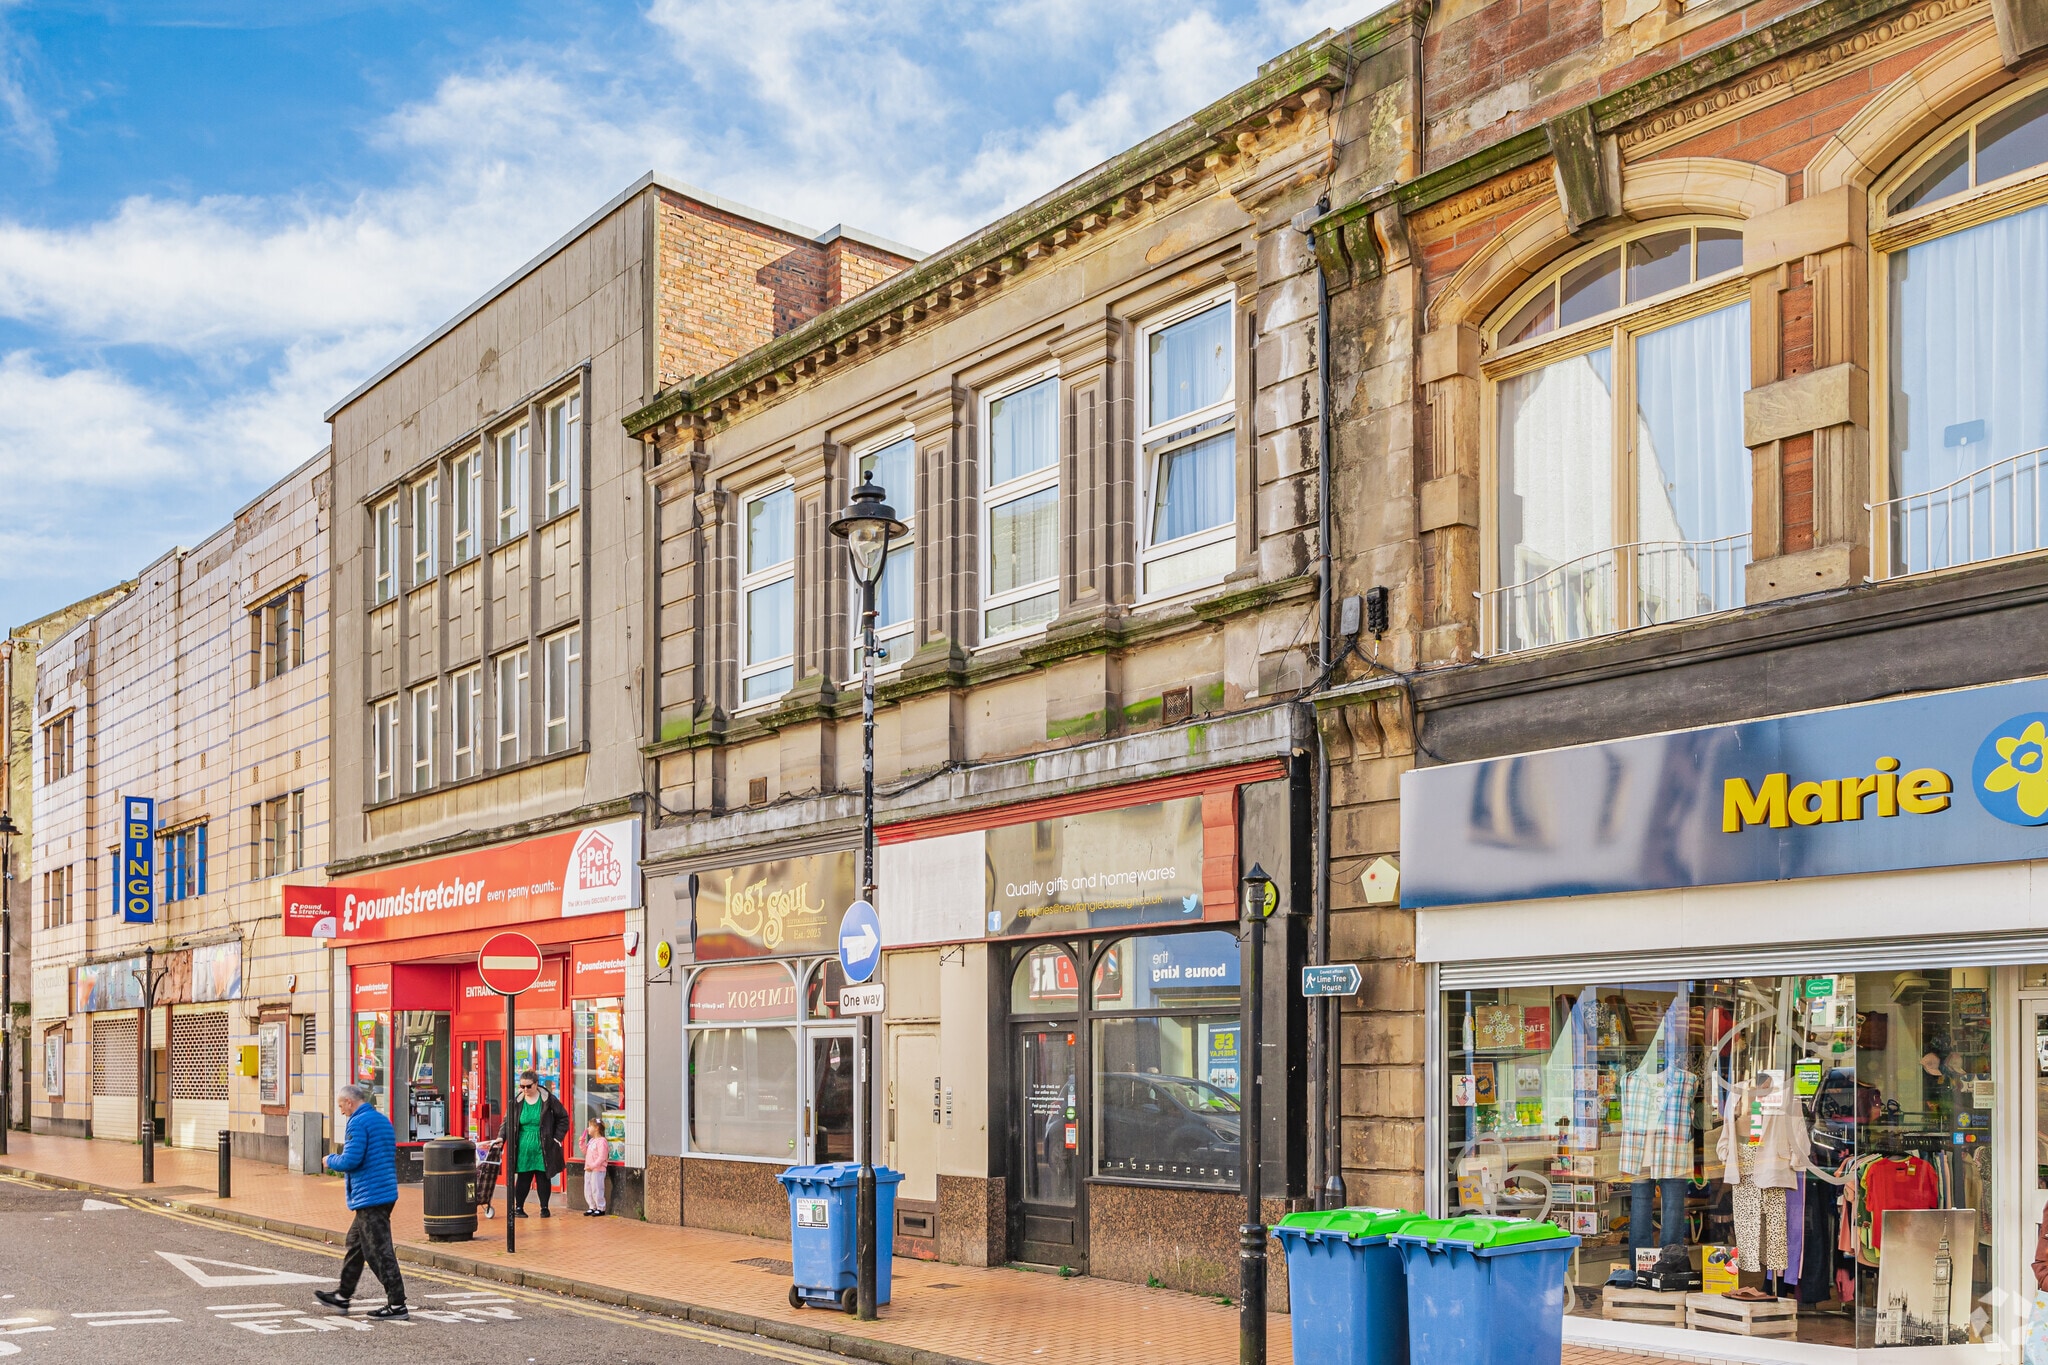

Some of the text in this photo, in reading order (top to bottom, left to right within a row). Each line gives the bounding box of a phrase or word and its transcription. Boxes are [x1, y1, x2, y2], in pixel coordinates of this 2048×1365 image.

[1722, 756, 1952, 834] Marie
[586, 845, 609, 867] Pet
[128, 823, 150, 914] BINGO
[586, 865, 609, 887] Hut
[1005, 866, 1176, 897] Quality gifts and homewares
[487, 887, 506, 902] every
[508, 884, 529, 900] penny
[591, 896, 610, 905] DISCOUNT
[660, 951, 669, 960] 46
[466, 985, 499, 998] ENTRAN
[843, 993, 881, 1008] One way
[1525, 1023, 1545, 1033] SALE
